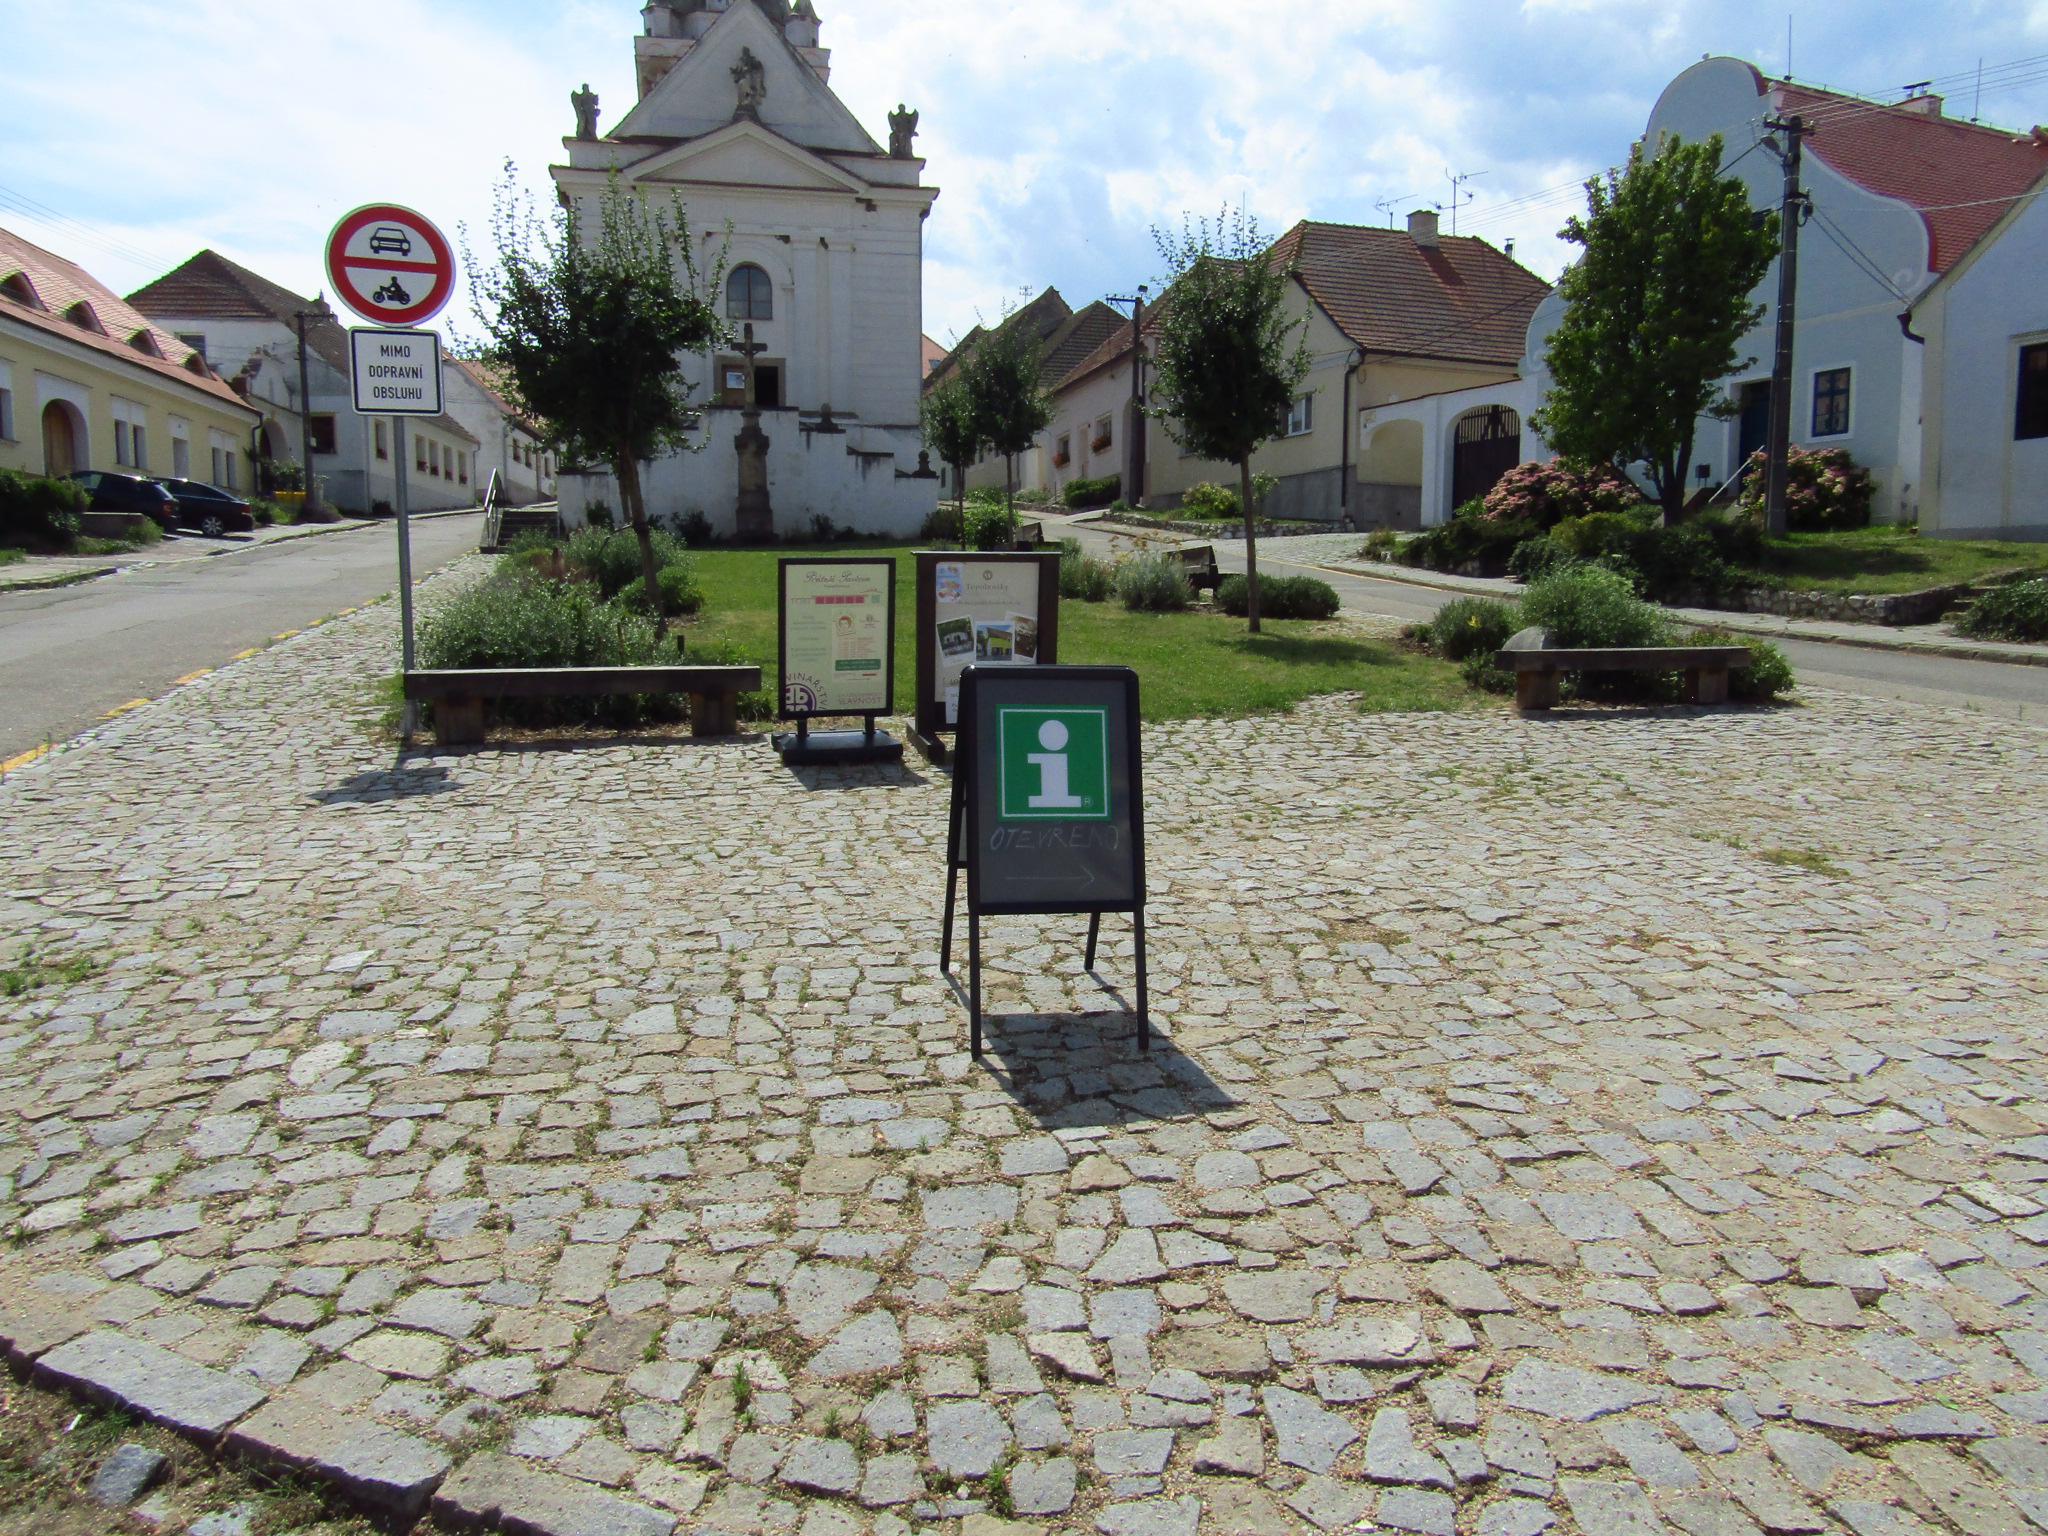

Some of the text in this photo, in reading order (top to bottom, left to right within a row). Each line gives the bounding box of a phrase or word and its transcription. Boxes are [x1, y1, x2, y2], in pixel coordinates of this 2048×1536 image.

[381, 345, 410, 358] MIMO
[369, 364, 423, 379] DOPRAVNÍ
[373, 386, 422, 400] OBSLUHU
